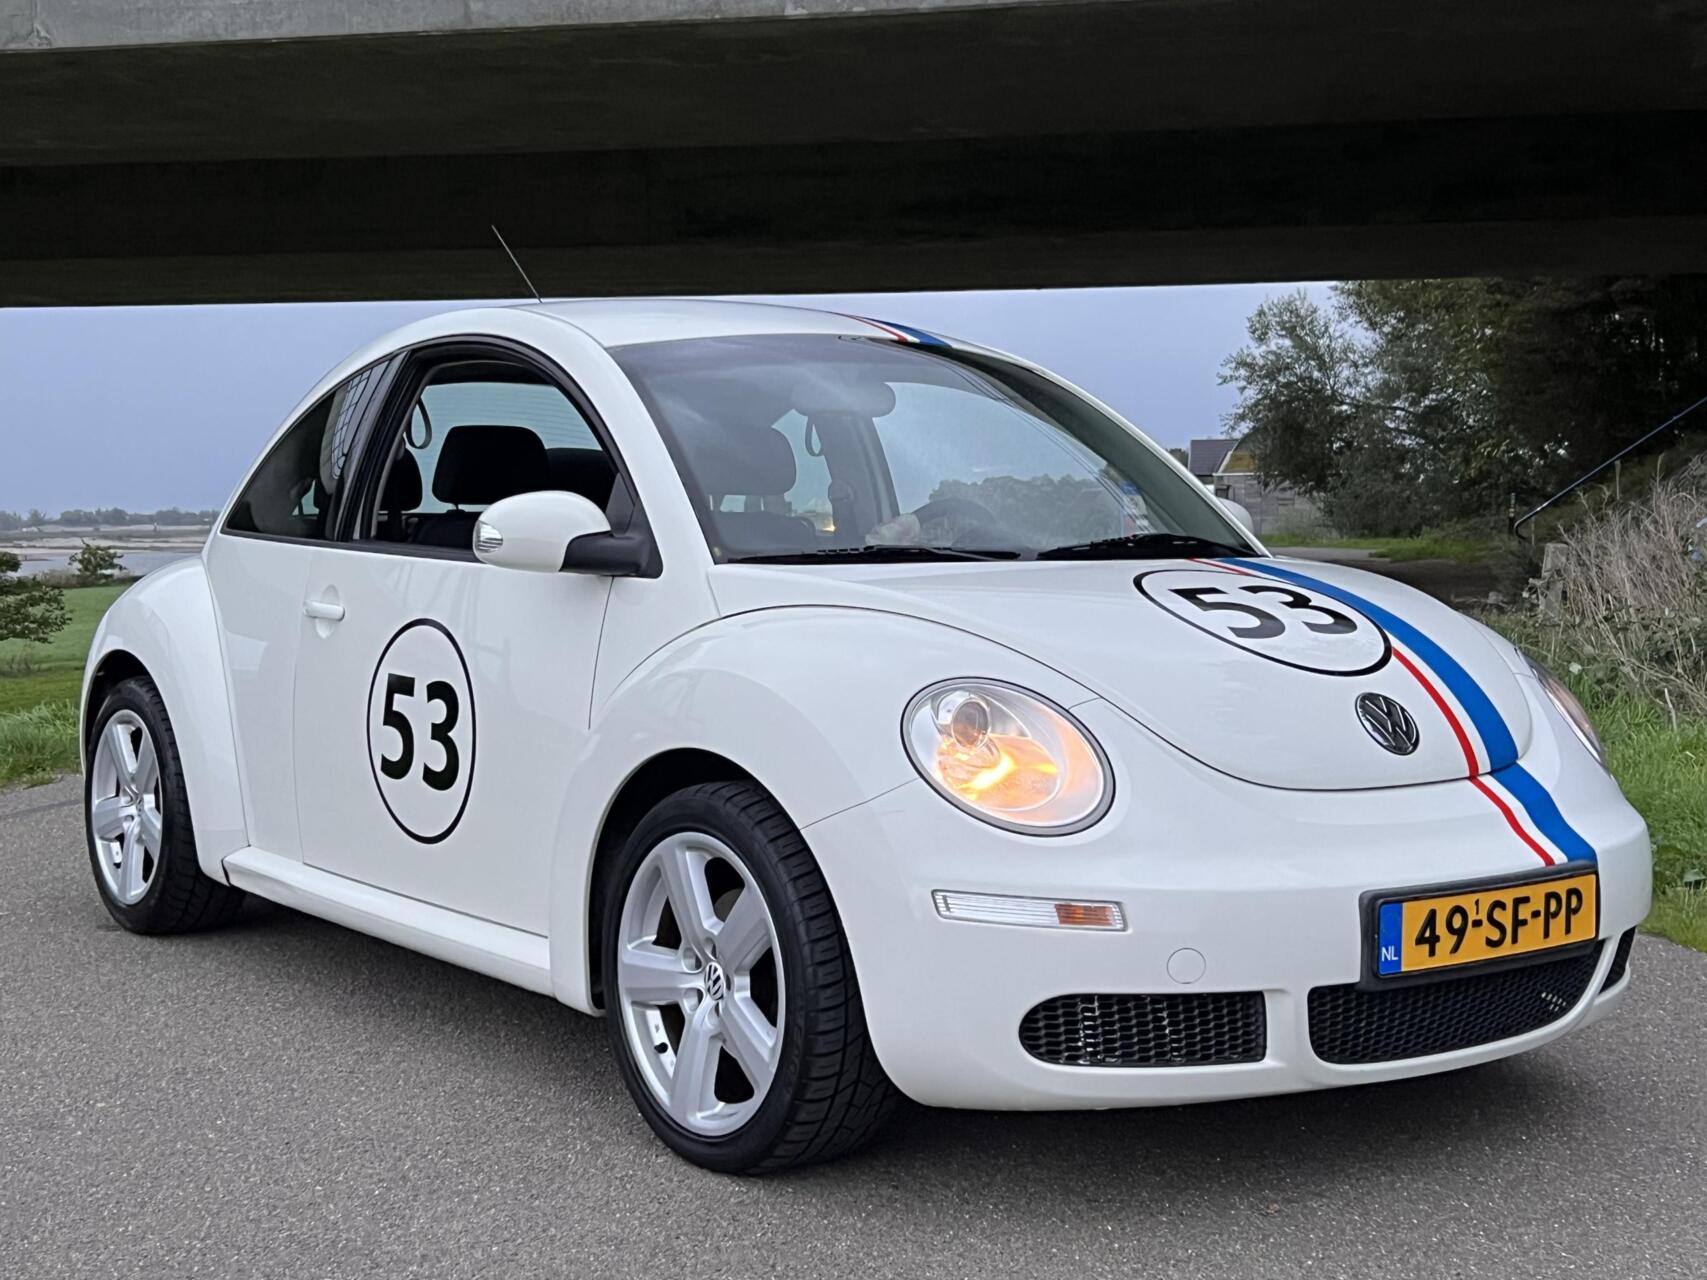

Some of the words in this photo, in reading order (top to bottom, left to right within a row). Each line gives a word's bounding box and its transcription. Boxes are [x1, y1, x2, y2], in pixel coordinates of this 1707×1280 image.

[1168, 586, 1357, 639] 53
[380, 673, 460, 791] 53
[1355, 692, 1420, 756] VW
[1381, 945, 1399, 962] NL
